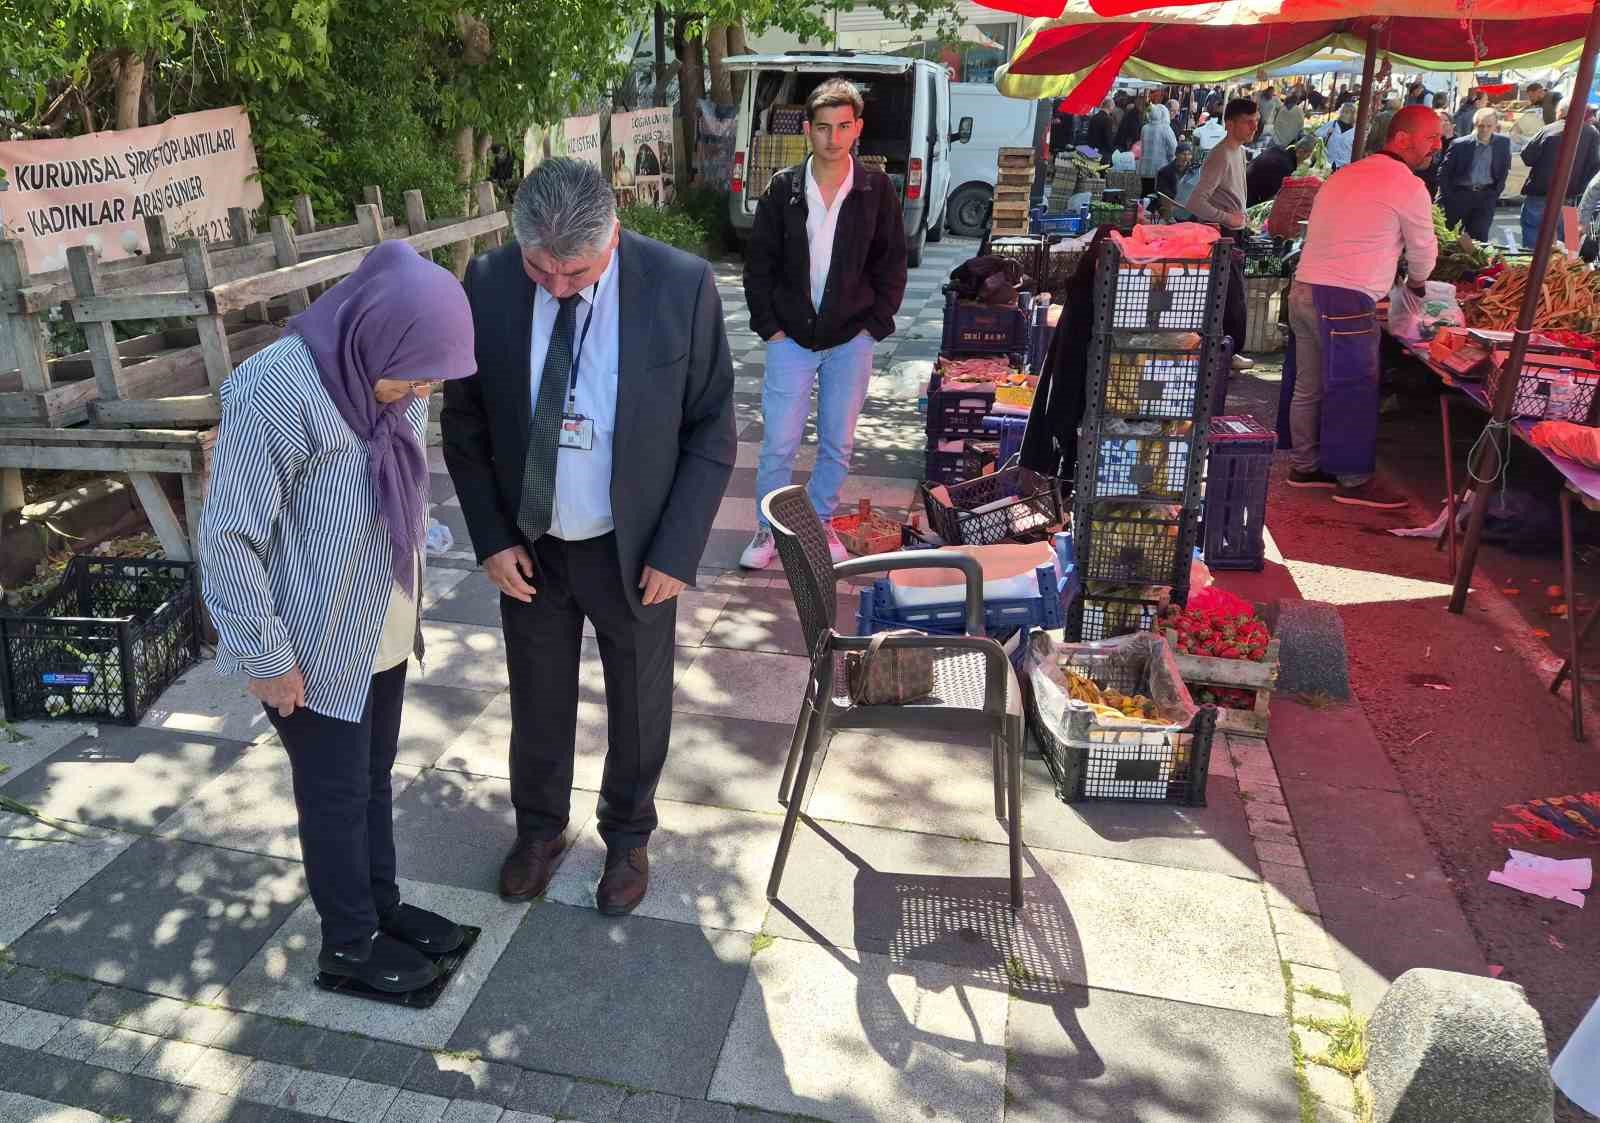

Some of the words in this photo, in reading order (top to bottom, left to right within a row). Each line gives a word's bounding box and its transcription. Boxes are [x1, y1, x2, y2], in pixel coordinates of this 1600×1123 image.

[15, 157, 125, 192] KURUMSAL
[27, 198, 126, 238] KADINLAR
[163, 176, 205, 209] GÜNLER
